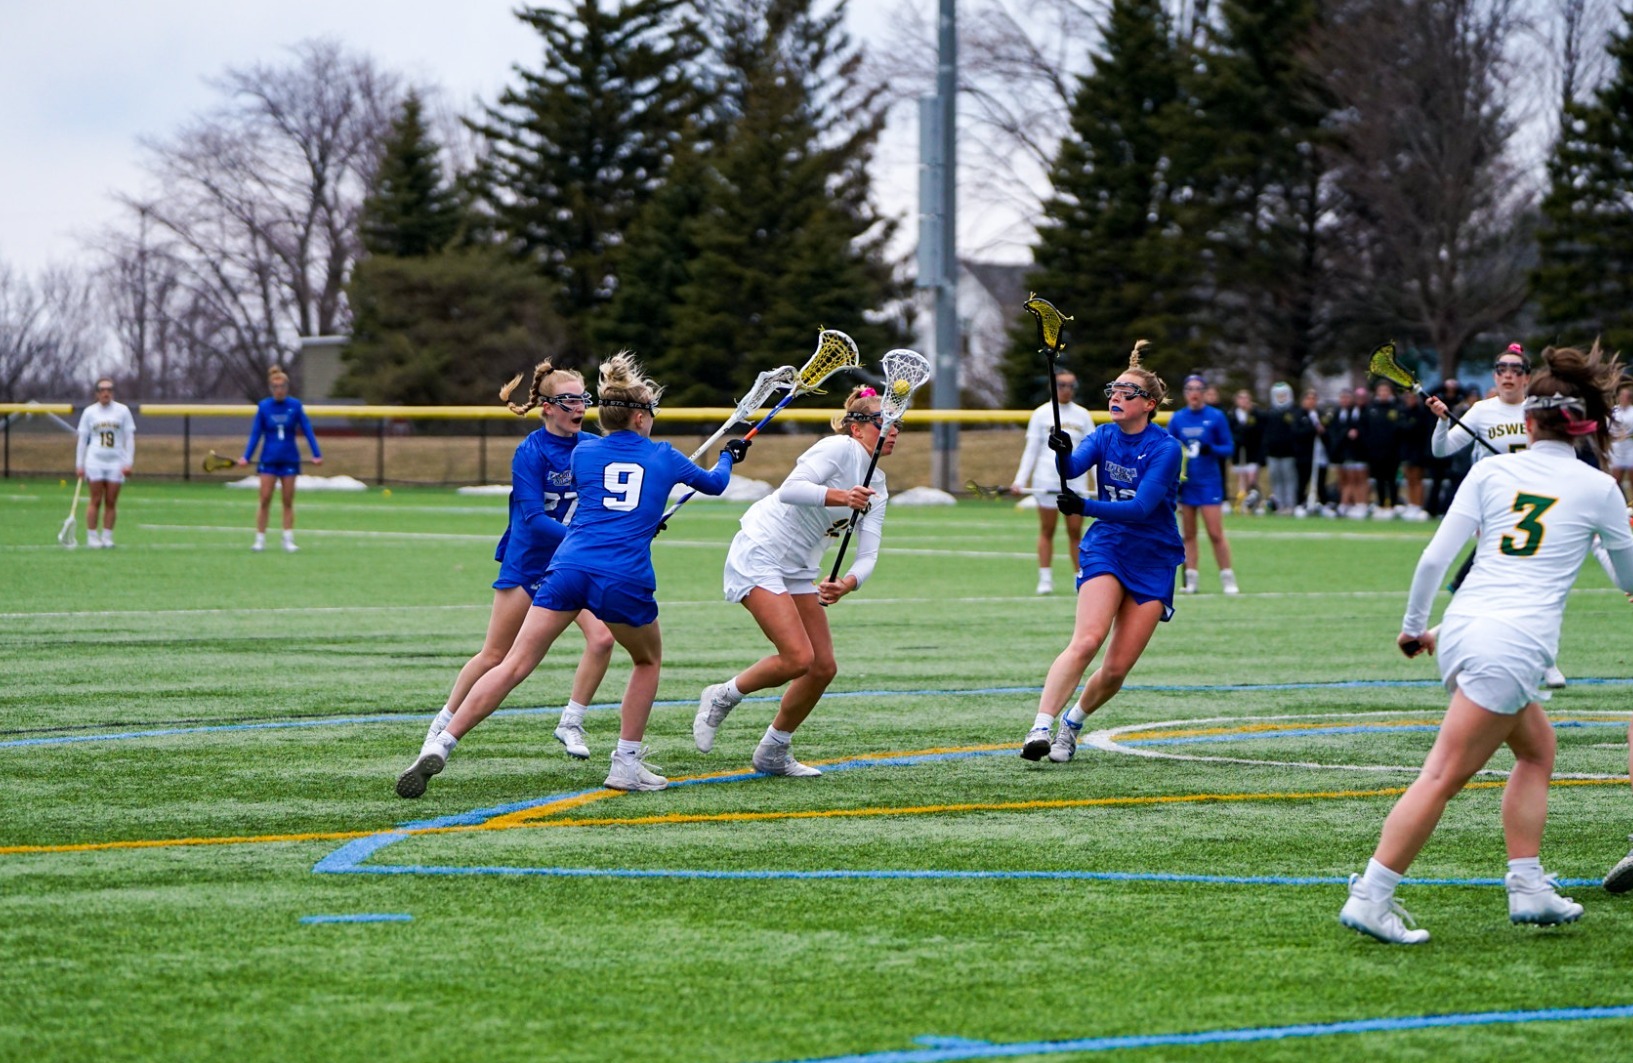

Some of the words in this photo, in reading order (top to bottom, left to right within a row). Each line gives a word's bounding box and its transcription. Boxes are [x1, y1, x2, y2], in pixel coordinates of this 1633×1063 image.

[100, 430, 115, 448] 19
[602, 462, 645, 512] 9
[1498, 489, 1559, 557] 3
